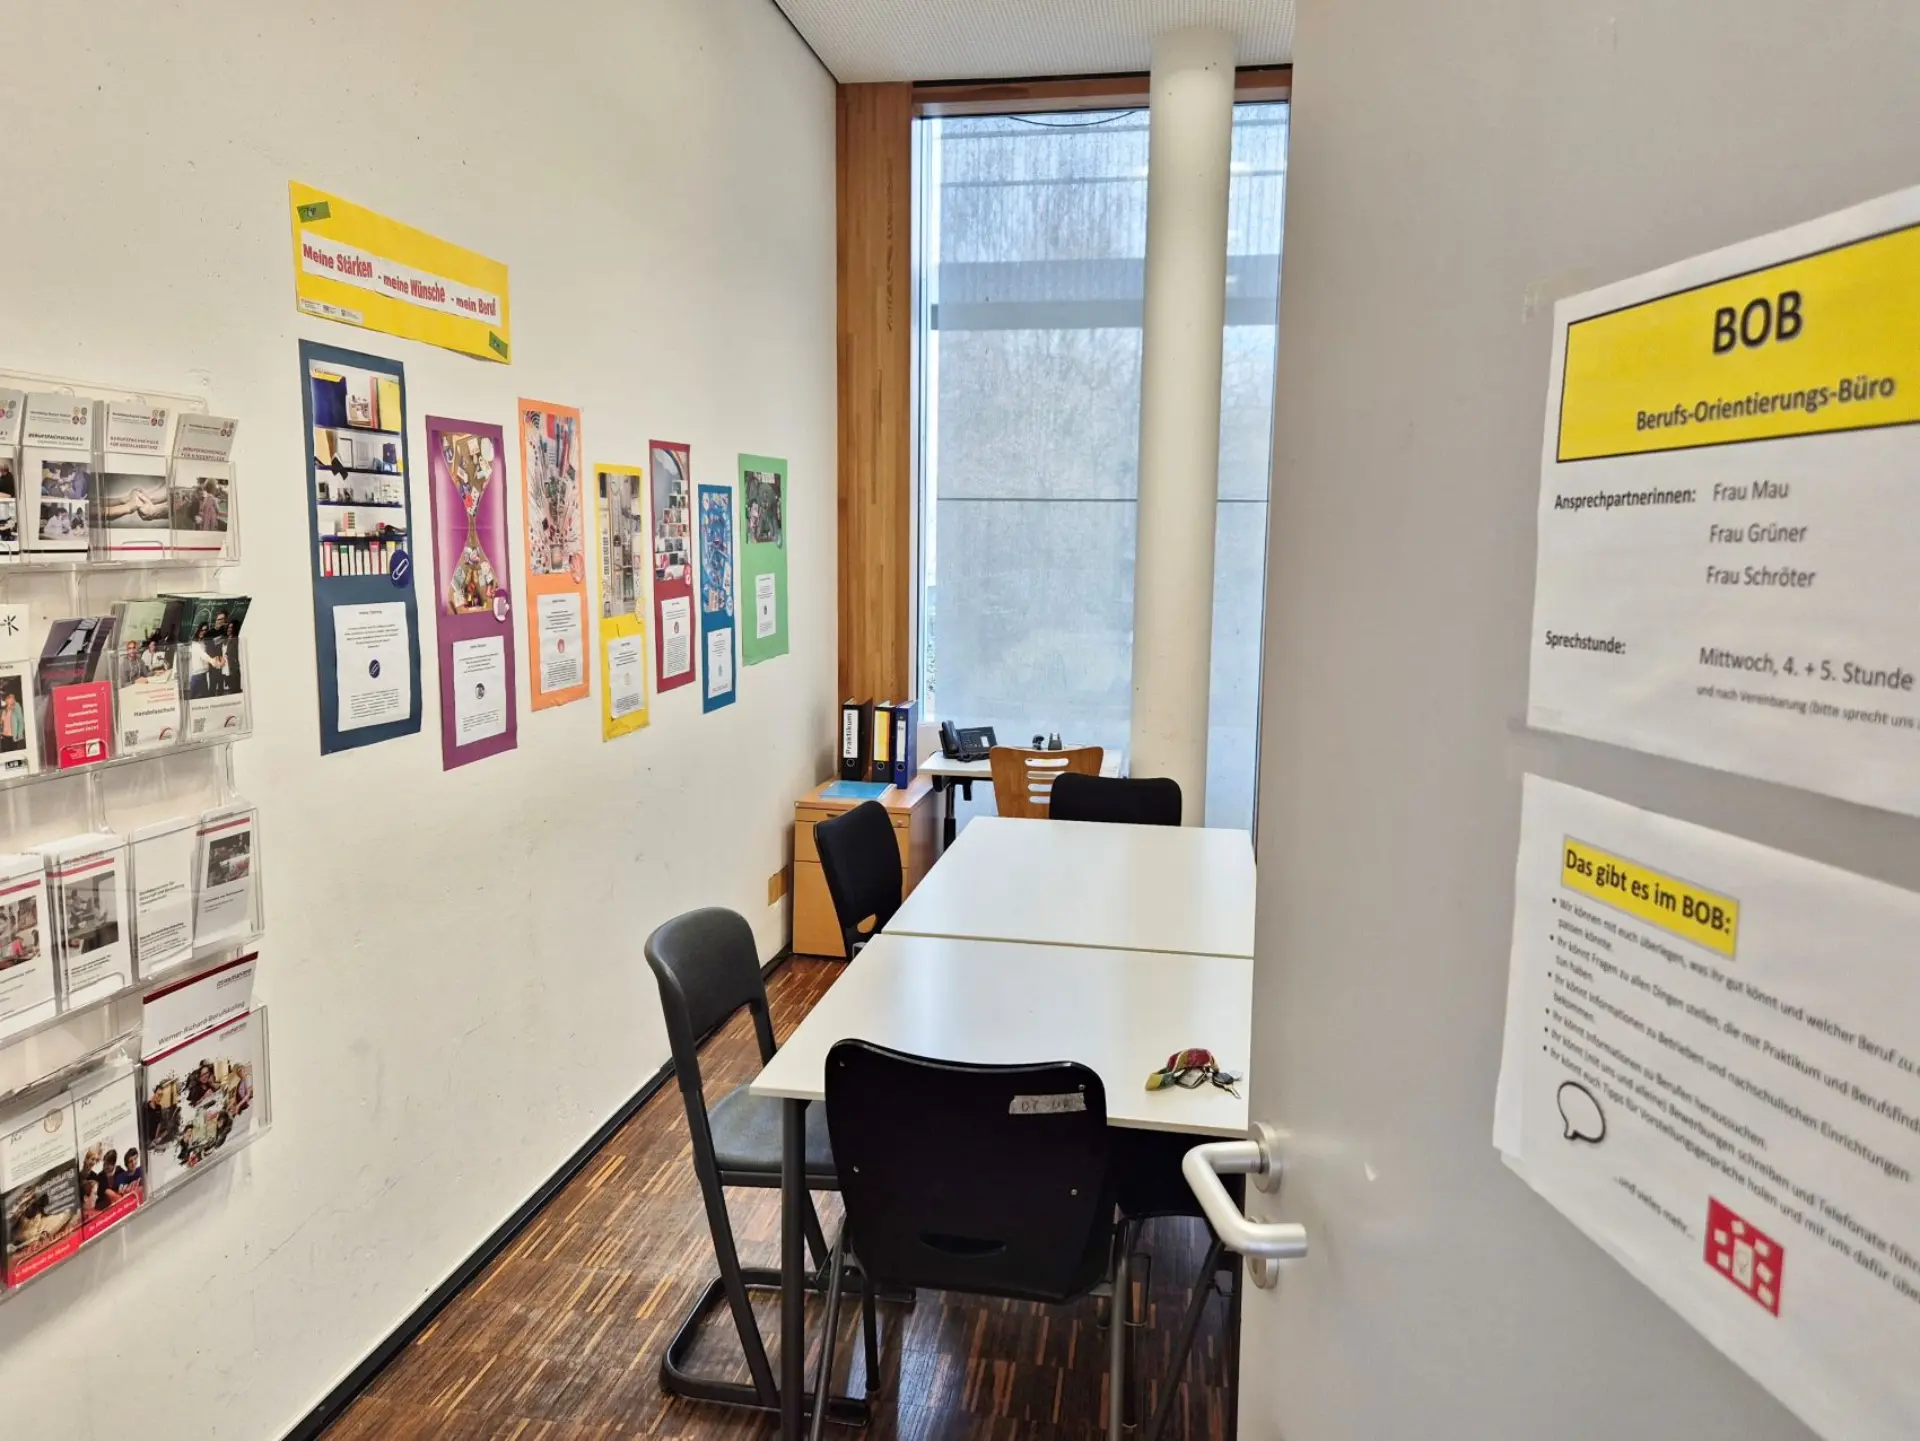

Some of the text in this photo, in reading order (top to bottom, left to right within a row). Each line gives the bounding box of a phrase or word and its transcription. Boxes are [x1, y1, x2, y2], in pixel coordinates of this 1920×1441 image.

[303, 243, 334, 269] Meine
[336, 253, 373, 278] Stärken
[384, 273, 408, 294] meine
[410, 279, 446, 304] Wünsche
[456, 297, 477, 313] mein
[1711, 290, 1803, 355] BOB
[1636, 374, 1895, 431] Berufs-Orientierungs-Büro
[1554, 486, 1697, 513] Ansprechpartnerinnen:
[1713, 478, 1790, 501] Frau Mau
[1708, 521, 1808, 544] Frau Grüner
[1706, 564, 1816, 587] Frau Schröter
[1545, 630, 1627, 655] Sprechstunde:
[1699, 647, 1915, 692] Mittwoch, 4. + 5. Stunde
[1697, 686, 1714, 697] und
[1716, 687, 1738, 701] nach
[1741, 690, 1807, 715] Vereinbarung
[1810, 699, 1840, 717] (bitte
[1842, 707, 1887, 726] sprecht
[1891, 715, 1915, 729] uns
[1566, 849, 1732, 936] Das gibt es im BOB:
[1618, 927, 1638, 943] euch
[1690, 960, 1708, 977] was
[1711, 968, 1725, 982] ihr
[1726, 977, 1744, 993] gut
[1746, 981, 1779, 1012] könnt
[1780, 1000, 1804, 1022] und
[1806, 1012, 1856, 1045] welcher
[1858, 1034, 1897, 1064] Beruf
[1898, 1056, 1913, 1074] zu
[1652, 983, 1684, 1009] Dingen
[1723, 1021, 1741, 1038] die
[1742, 1032, 1761, 1051] mit
[1762, 1040, 1821, 1080] Praktikum
[1824, 1074, 1848, 1096] und
[1851, 1085, 1920, 1136] Berufsfind
[1706, 1060, 1727, 1078] und
[1728, 1072, 1818, 1130] nachschulischen
[1820, 1120, 1910, 1183] Einrichtungen
[1668, 1102, 1736, 1156] Bewerbungen
[1738, 1148, 1790, 1191] schreiben
[1792, 1184, 1815, 1206] und
[1818, 1199, 1888, 1254] Telefonate
[1890, 1242, 1920, 1275] führ
[1746, 1176, 1778, 1208] holen
[1780, 1202, 1802, 1226] und
[1804, 1218, 1826, 1238] mit
[1828, 1234, 1851, 1256] uns
[1853, 1249, 1890, 1282] dafür
